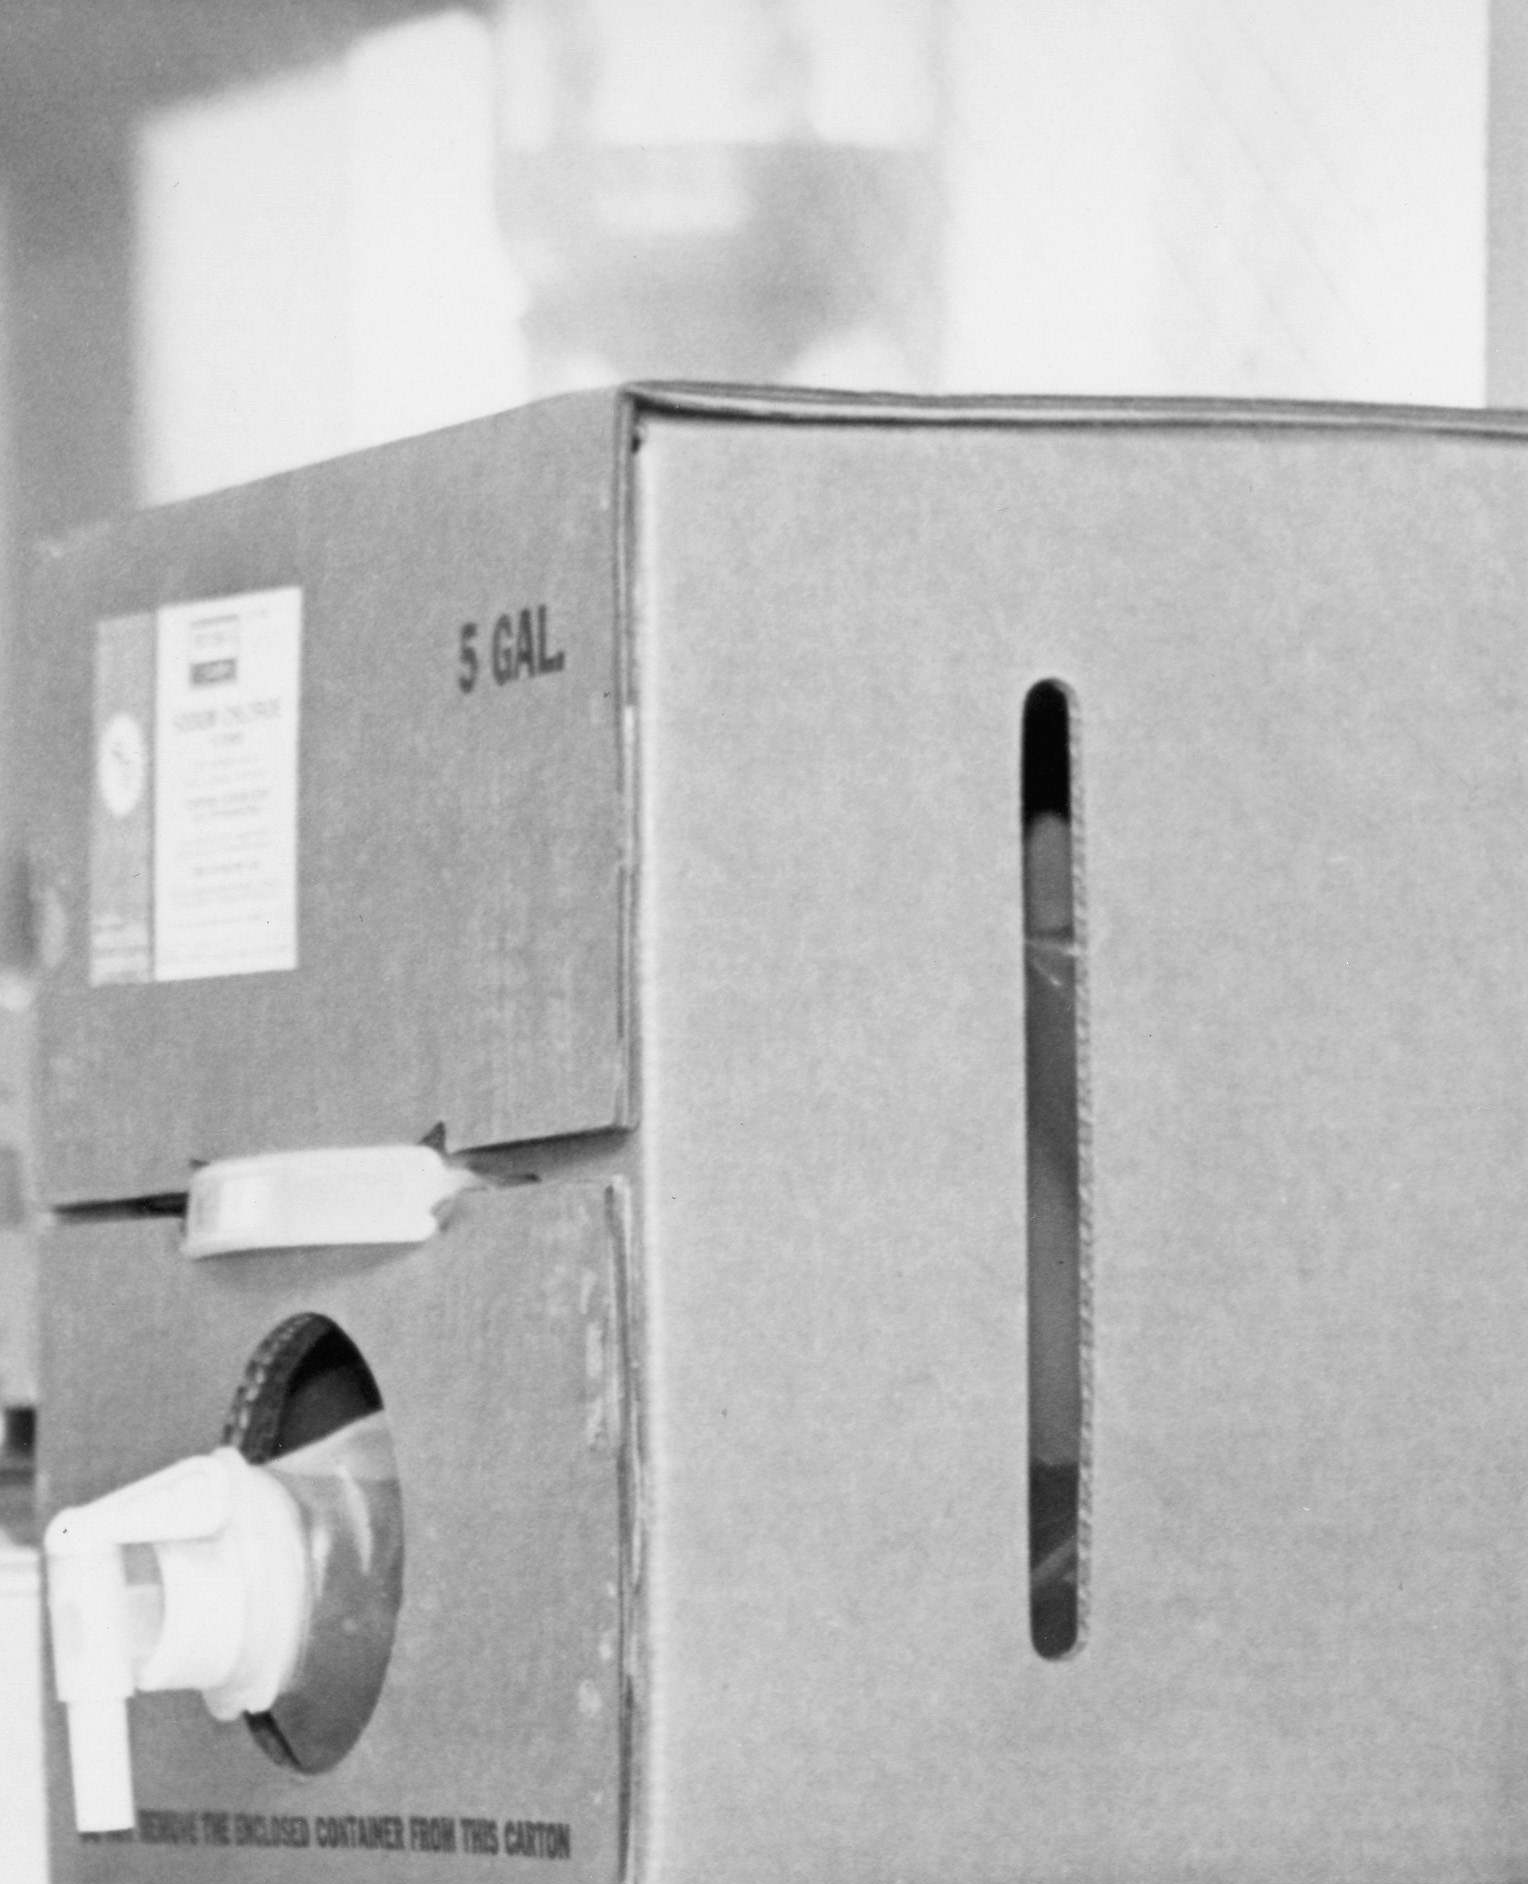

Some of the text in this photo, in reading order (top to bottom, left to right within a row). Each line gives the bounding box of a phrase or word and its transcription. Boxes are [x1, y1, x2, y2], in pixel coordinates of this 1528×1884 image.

[458, 621, 478, 694] 5
[200, 1812, 230, 1846] THE
[234, 1815, 311, 1849] ENCLOSED
[315, 1816, 405, 1851] CONTAINER
[409, 1817, 457, 1854] FROM
[460, 1818, 500, 1856] THIS
[503, 1820, 572, 1860] CARTON
